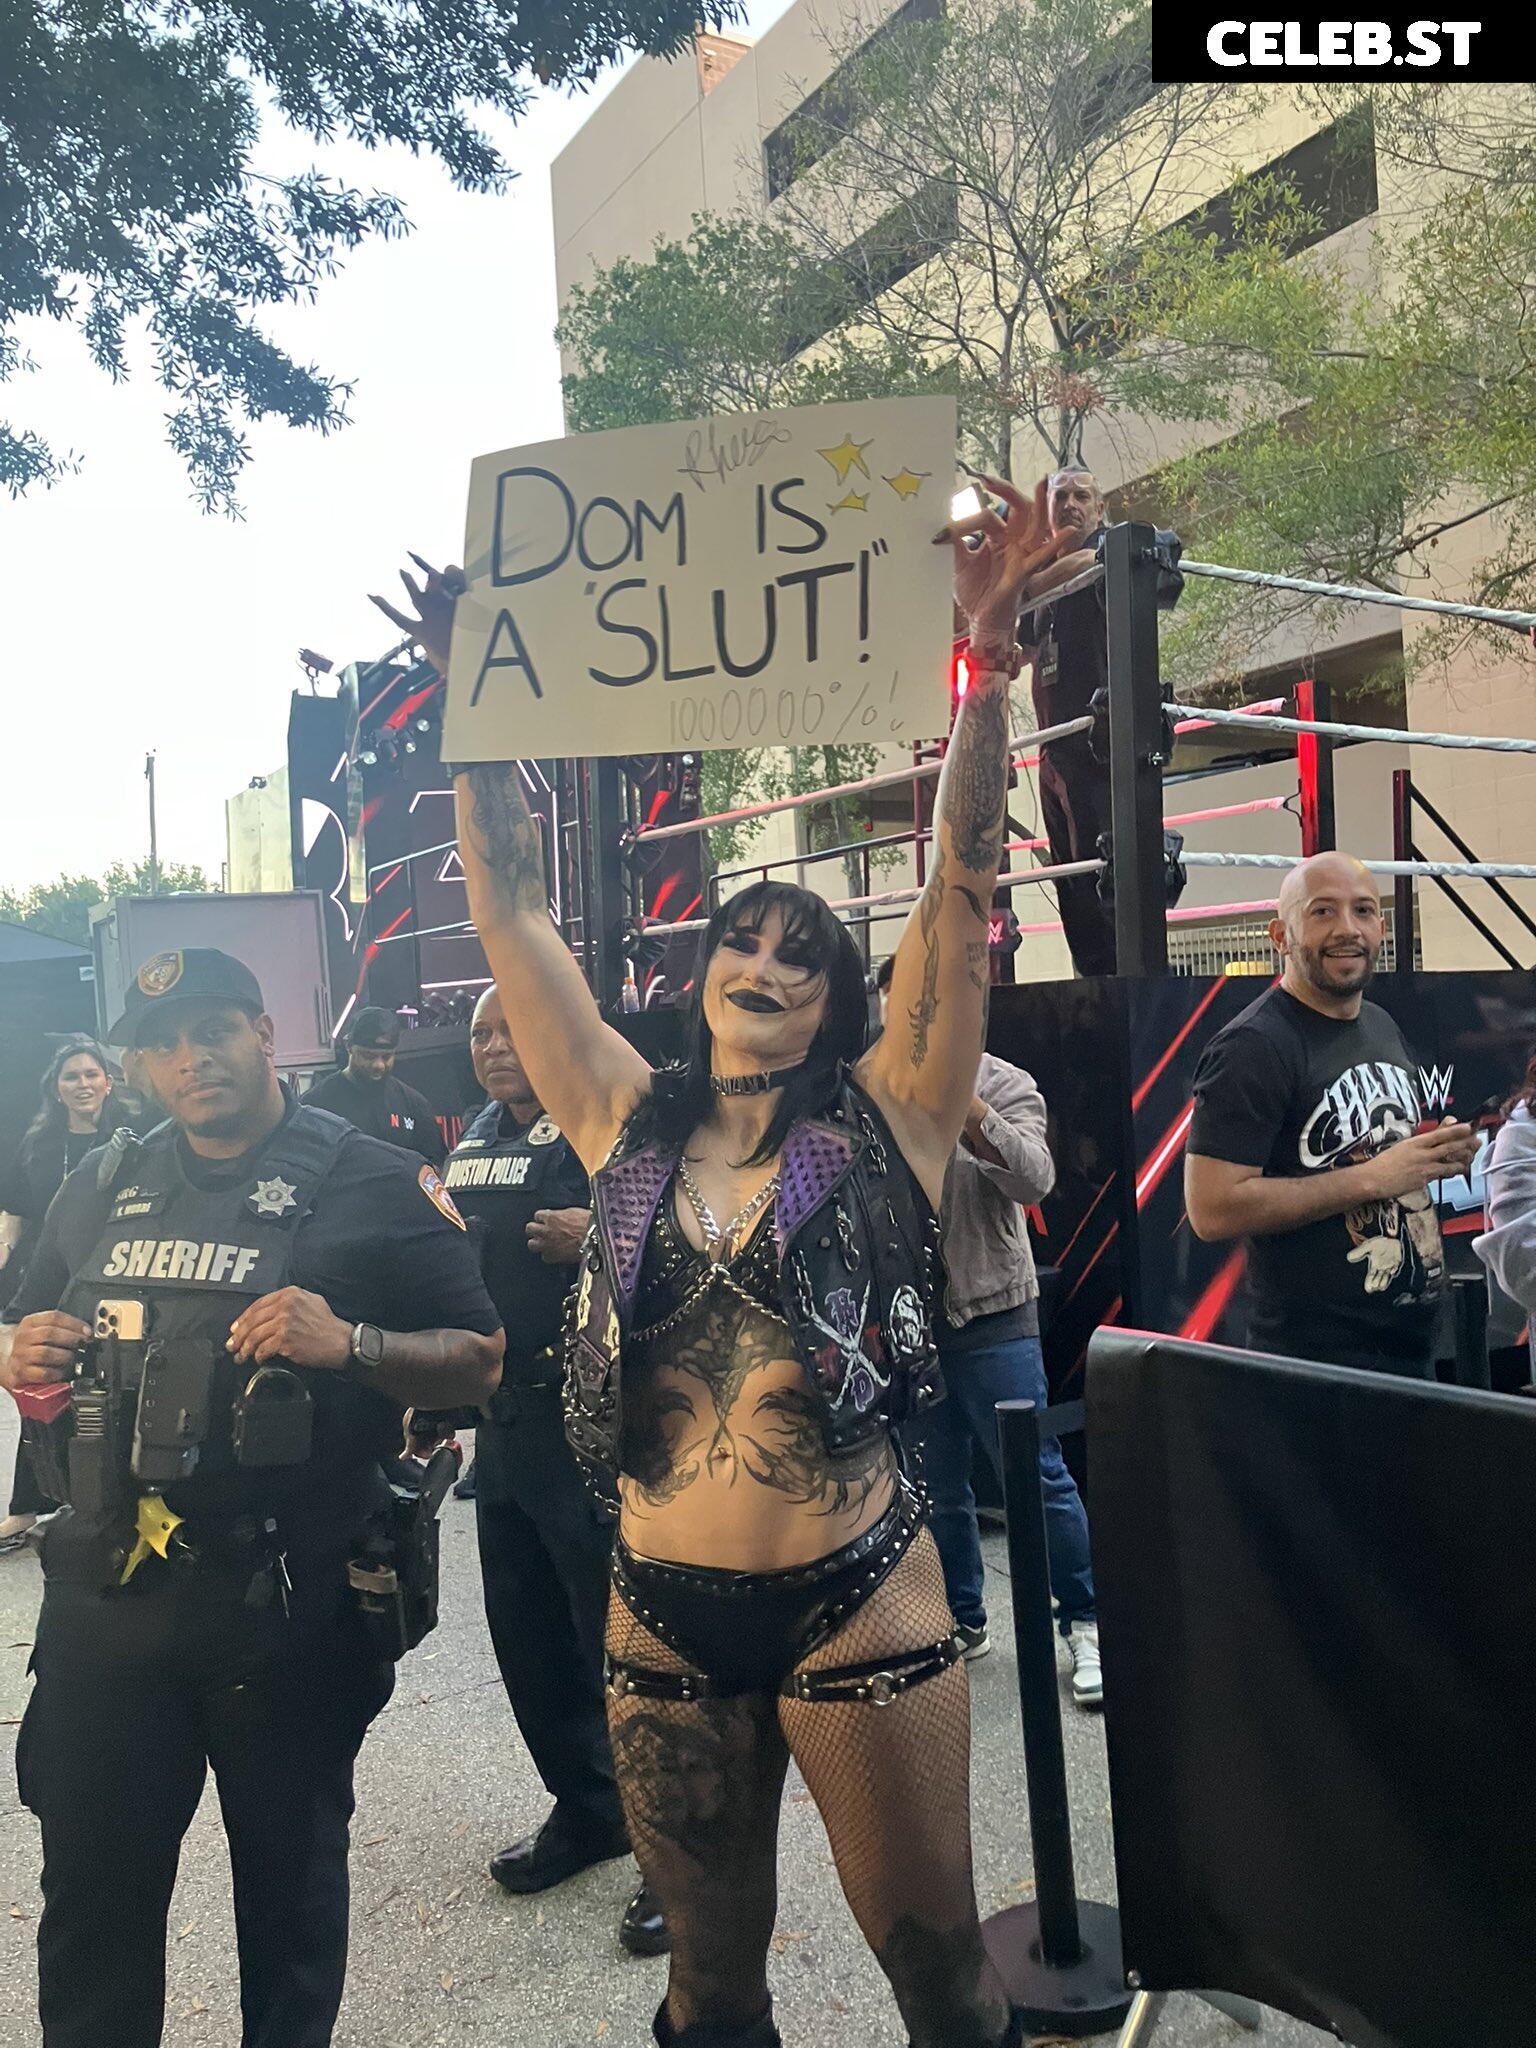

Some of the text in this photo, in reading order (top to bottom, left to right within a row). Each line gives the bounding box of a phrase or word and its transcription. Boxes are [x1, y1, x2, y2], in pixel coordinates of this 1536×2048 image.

[757, 477, 828, 555] IS
[469, 607, 544, 708] A
[487, 1156, 532, 1185] POLICE
[102, 1239, 260, 1284] SHERIFF
